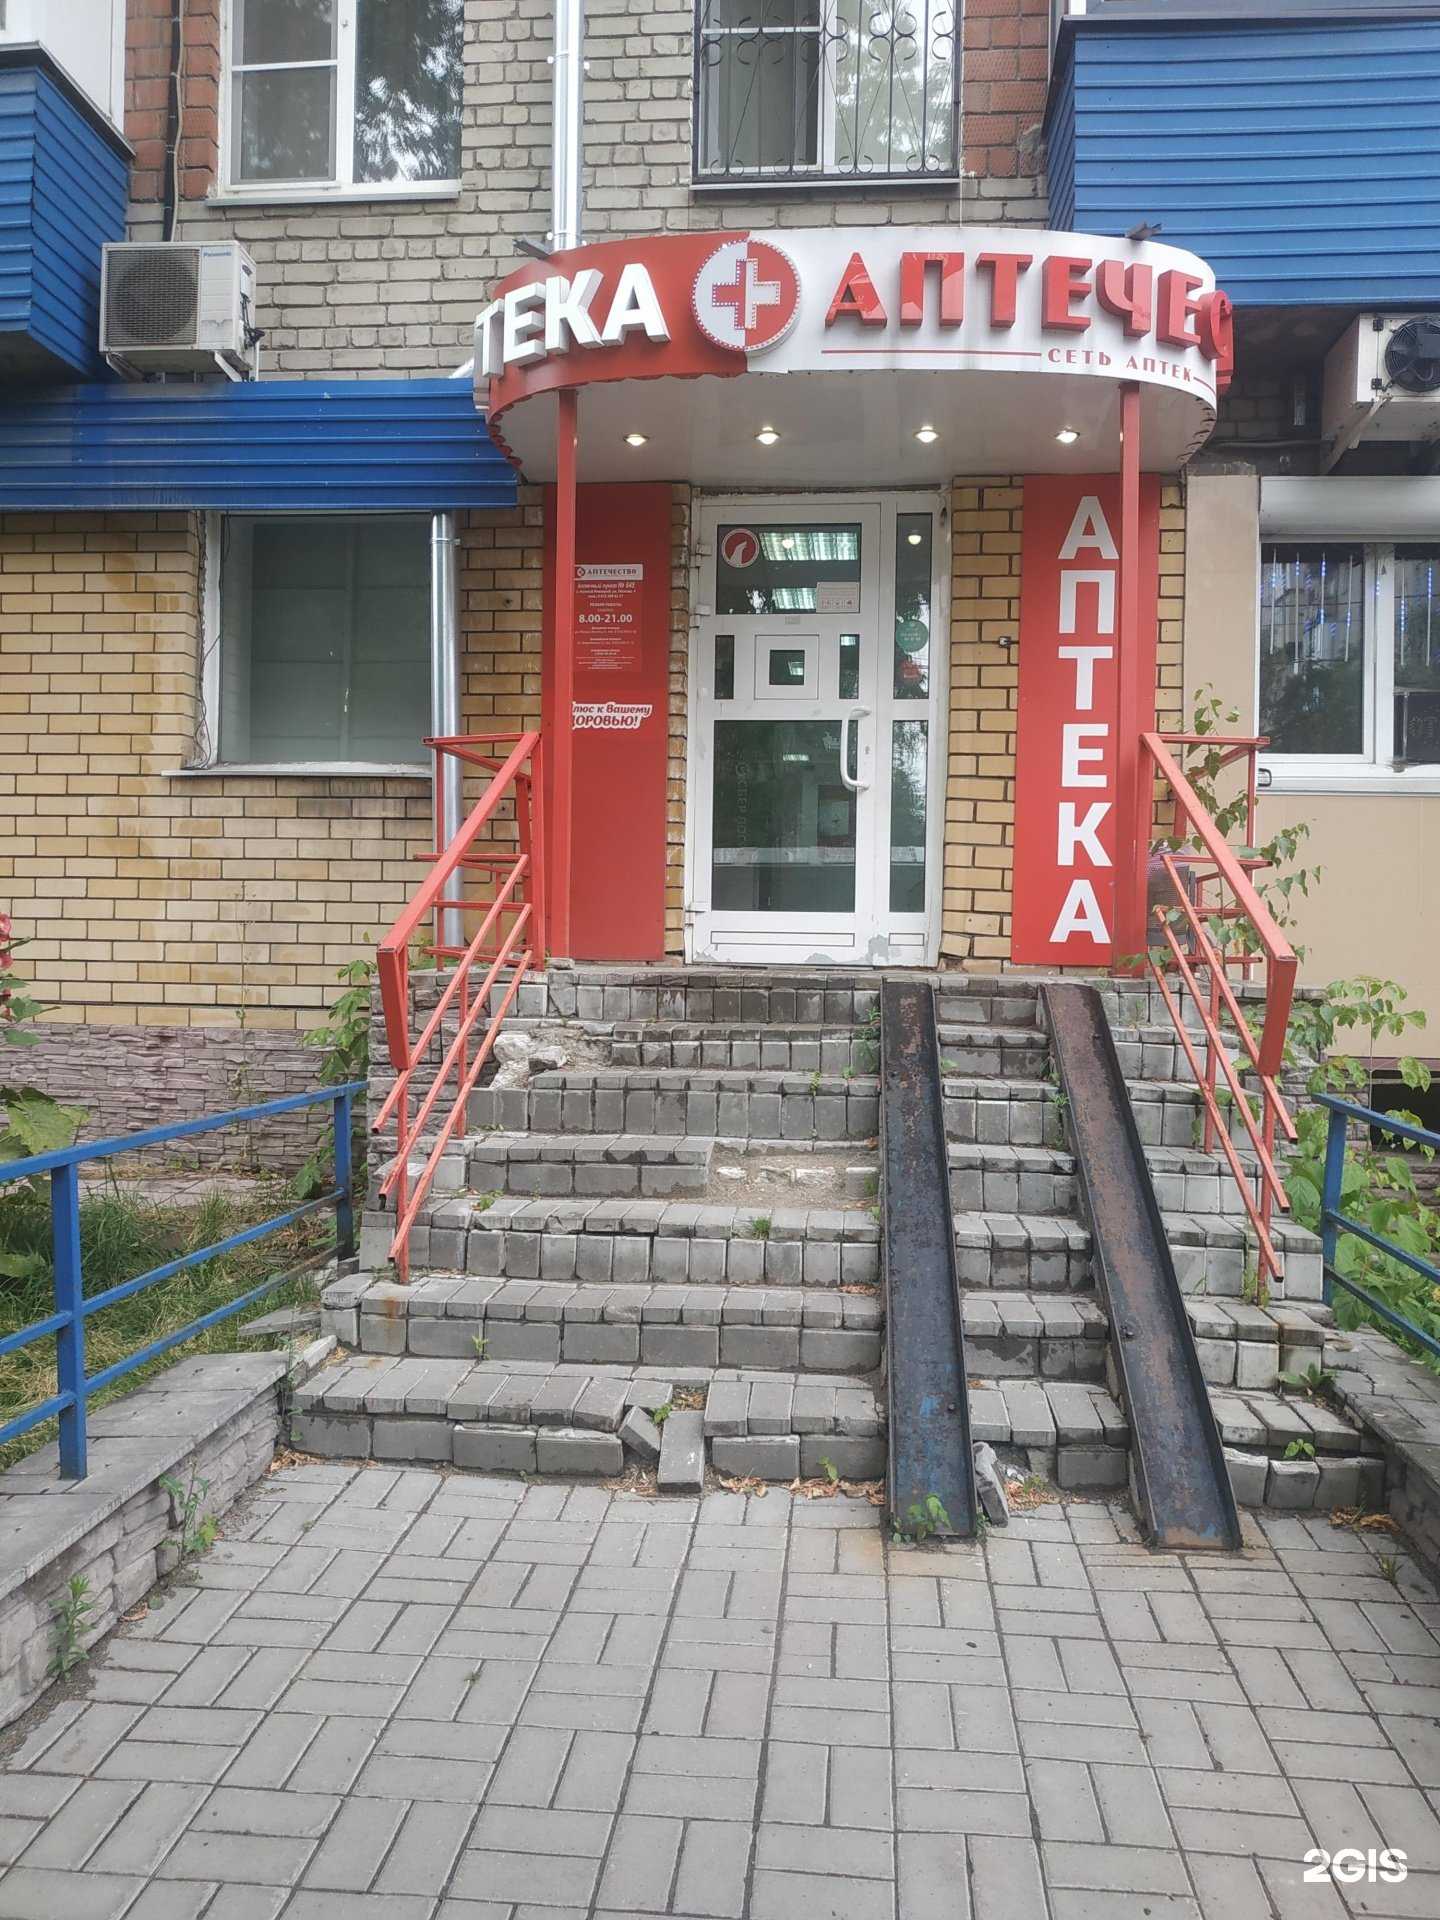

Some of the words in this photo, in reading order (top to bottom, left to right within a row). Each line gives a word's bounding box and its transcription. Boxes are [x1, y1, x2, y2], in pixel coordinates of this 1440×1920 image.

[474, 263, 672, 379] ТЕКА
[824, 250, 1234, 362] АПТЕЧЕС
[1048, 348, 1112, 365] СЕТЬ
[1126, 355, 1193, 383] АПТЕК
[578, 613, 633, 624] 8.00-21.00
[572, 715, 638, 727] ОРОВЬЮ!
[606, 704, 651, 715] Вашему
[1048, 495, 1120, 944] АПТЕКА
